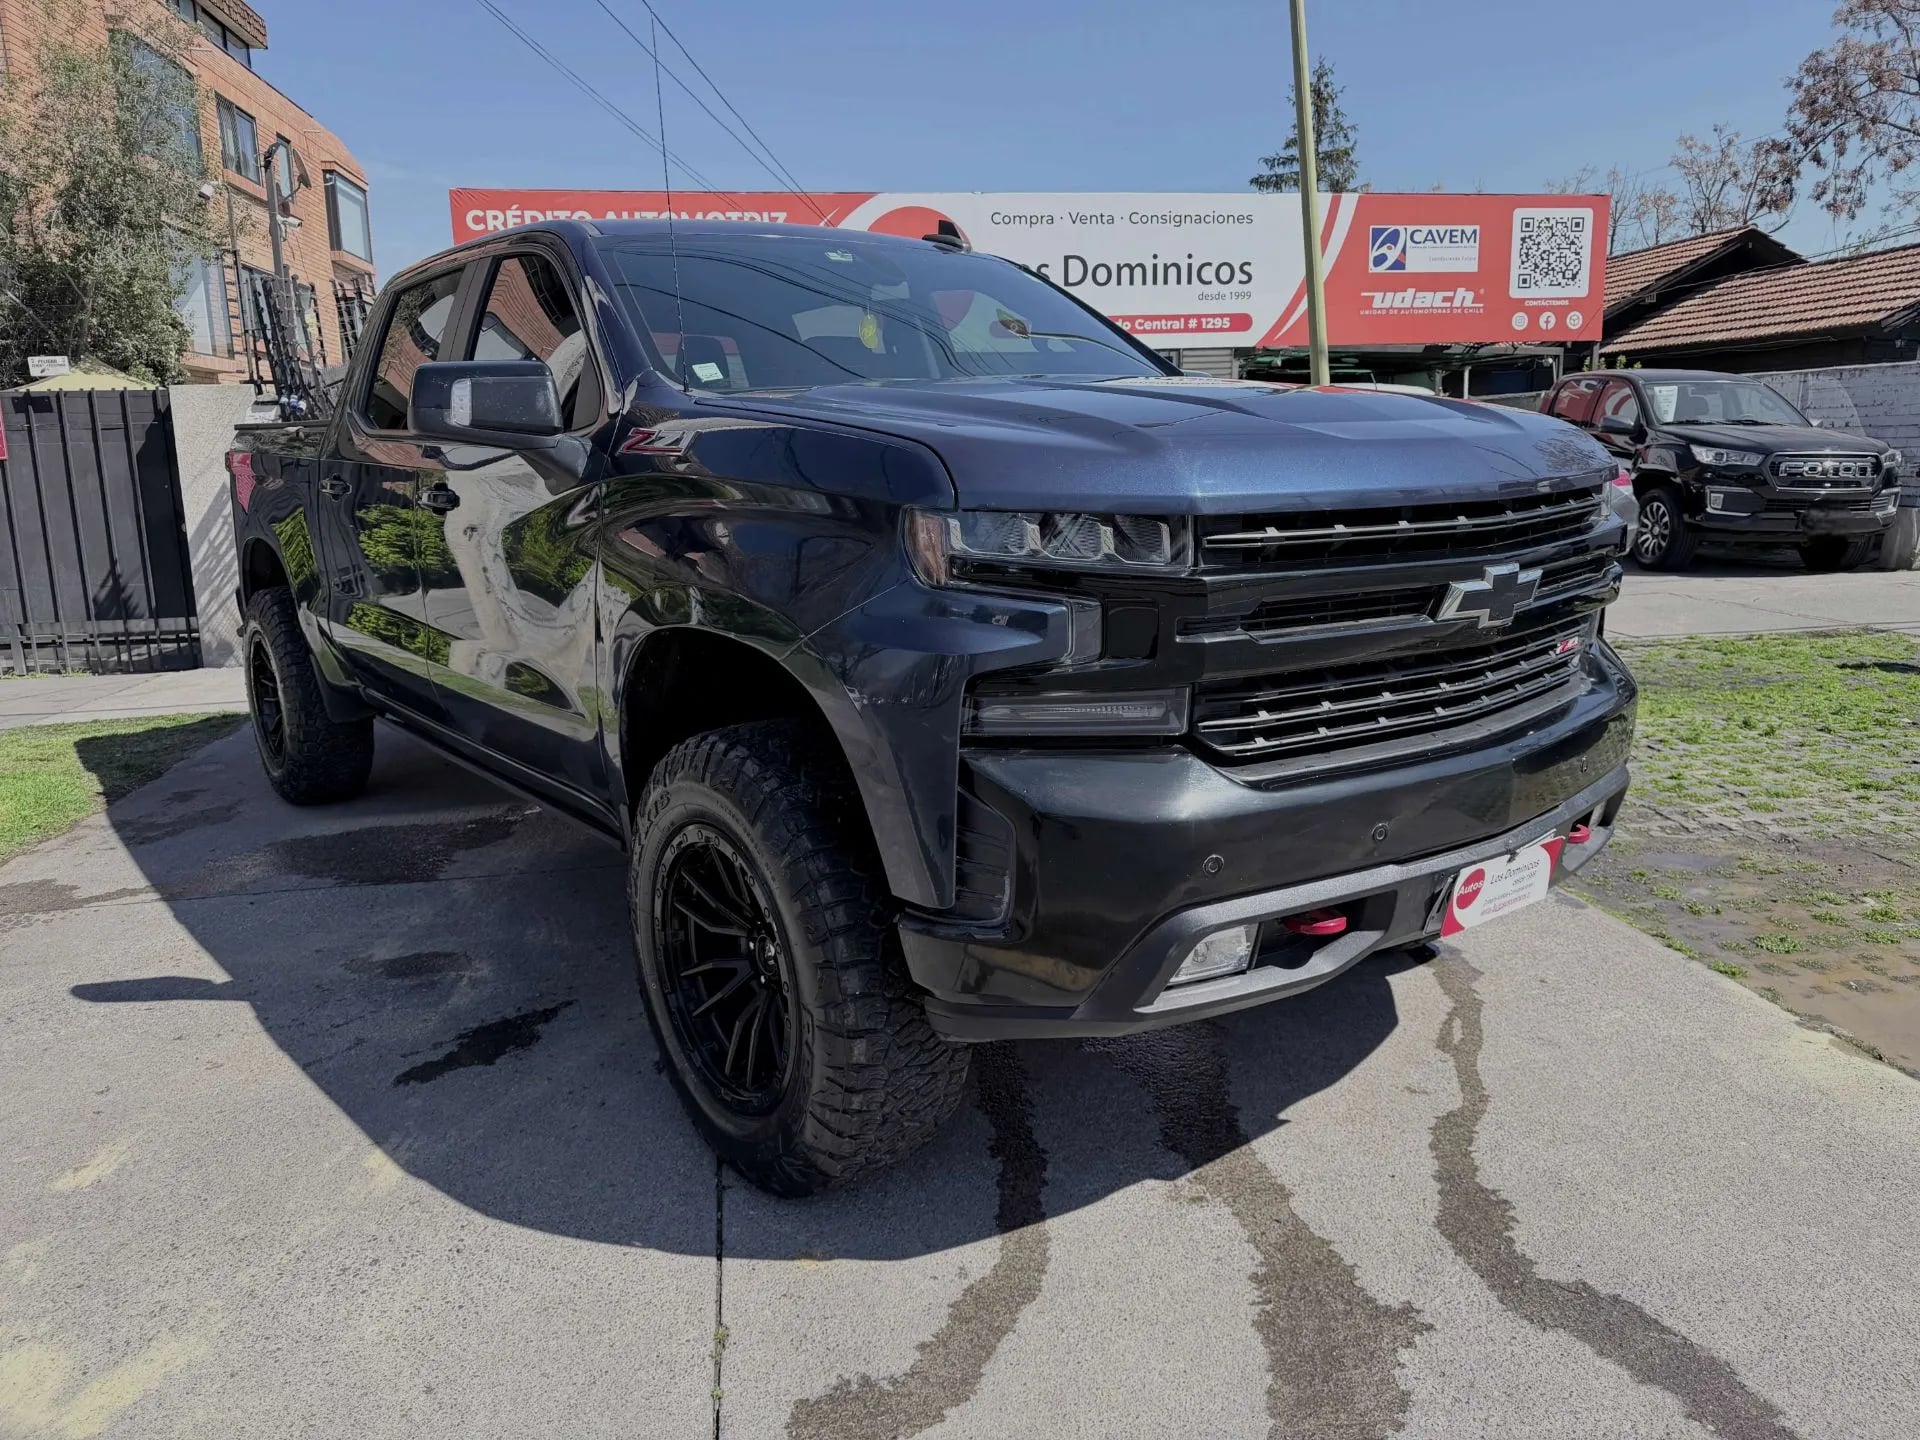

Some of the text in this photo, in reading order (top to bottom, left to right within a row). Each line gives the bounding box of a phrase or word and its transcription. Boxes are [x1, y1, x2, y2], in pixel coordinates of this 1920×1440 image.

[991, 211, 1254, 228] Compra Venta Consignaciones
[1409, 228, 1477, 244] CAVEM
[1063, 253, 1253, 287] Dominicos
[1198, 291, 1252, 301] desde 1999
[1135, 318, 1184, 330] Central
[1188, 319, 1198, 328] #
[1201, 317, 1231, 329] 1295
[1457, 879, 1484, 897] Autos
